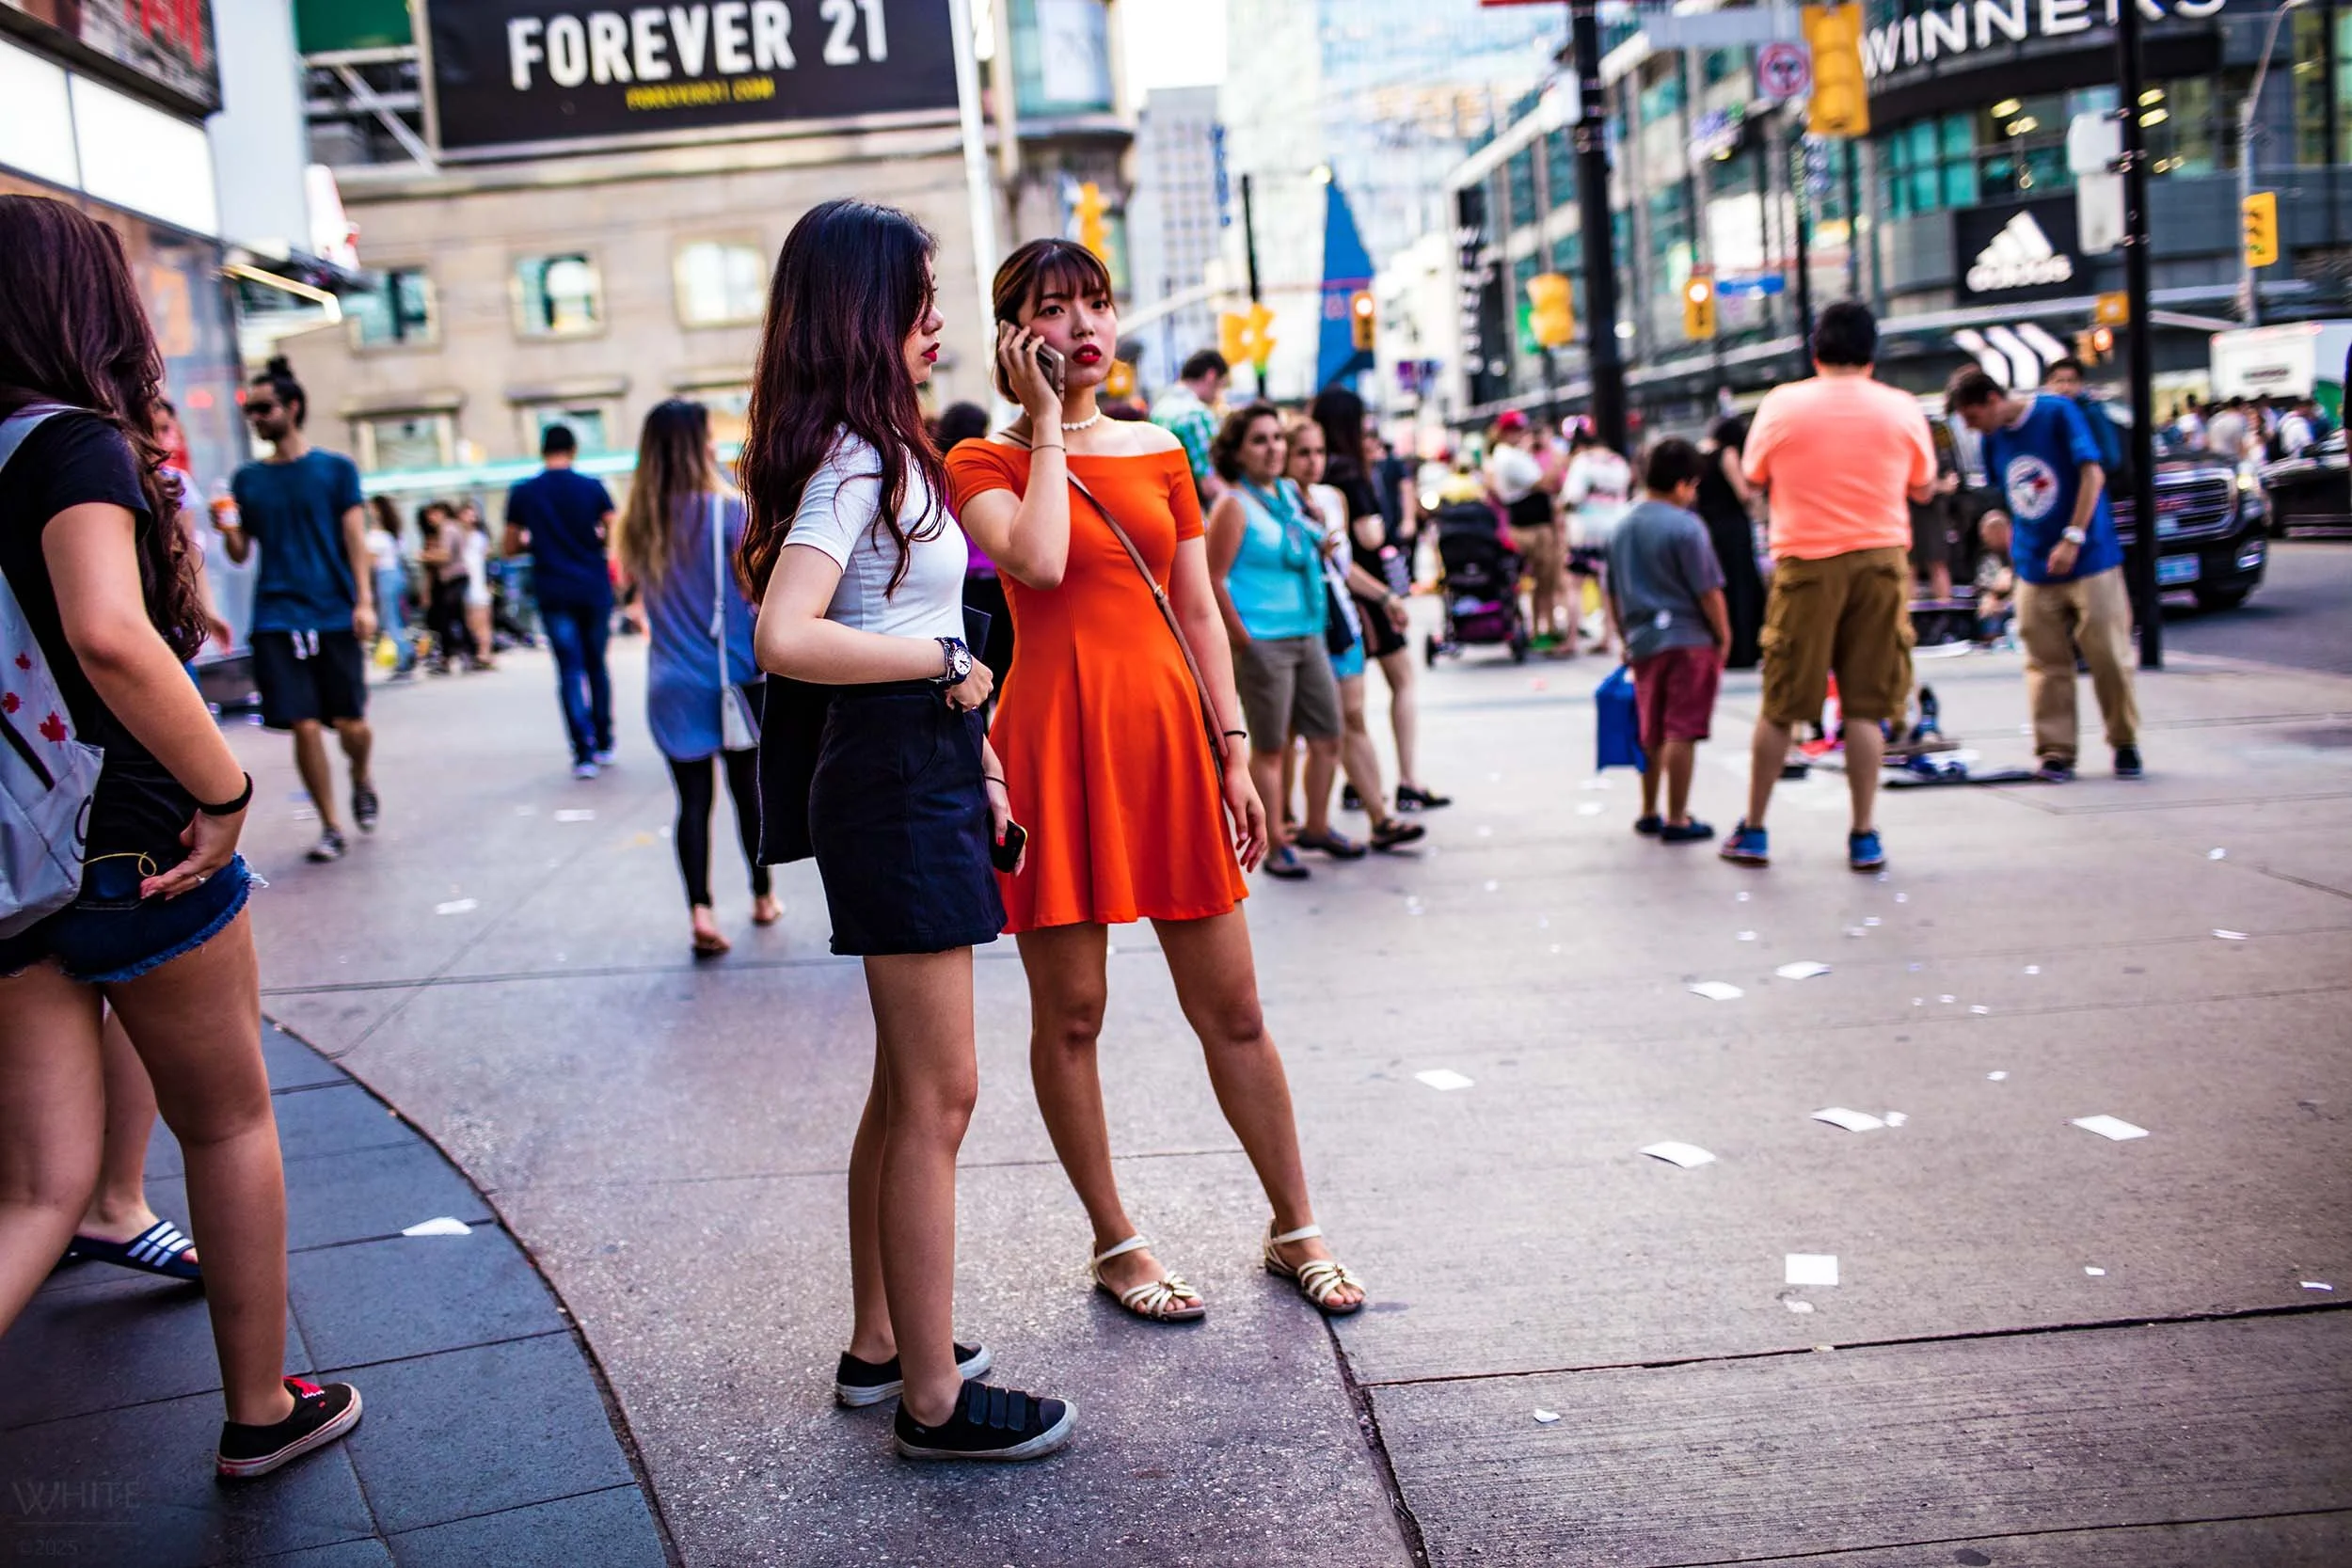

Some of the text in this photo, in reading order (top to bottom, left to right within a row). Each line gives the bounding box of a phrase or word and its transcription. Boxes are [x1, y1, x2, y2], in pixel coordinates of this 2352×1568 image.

[505, 0, 888, 91] FOREVER 21
[1857, 0, 2226, 79] WINNE
